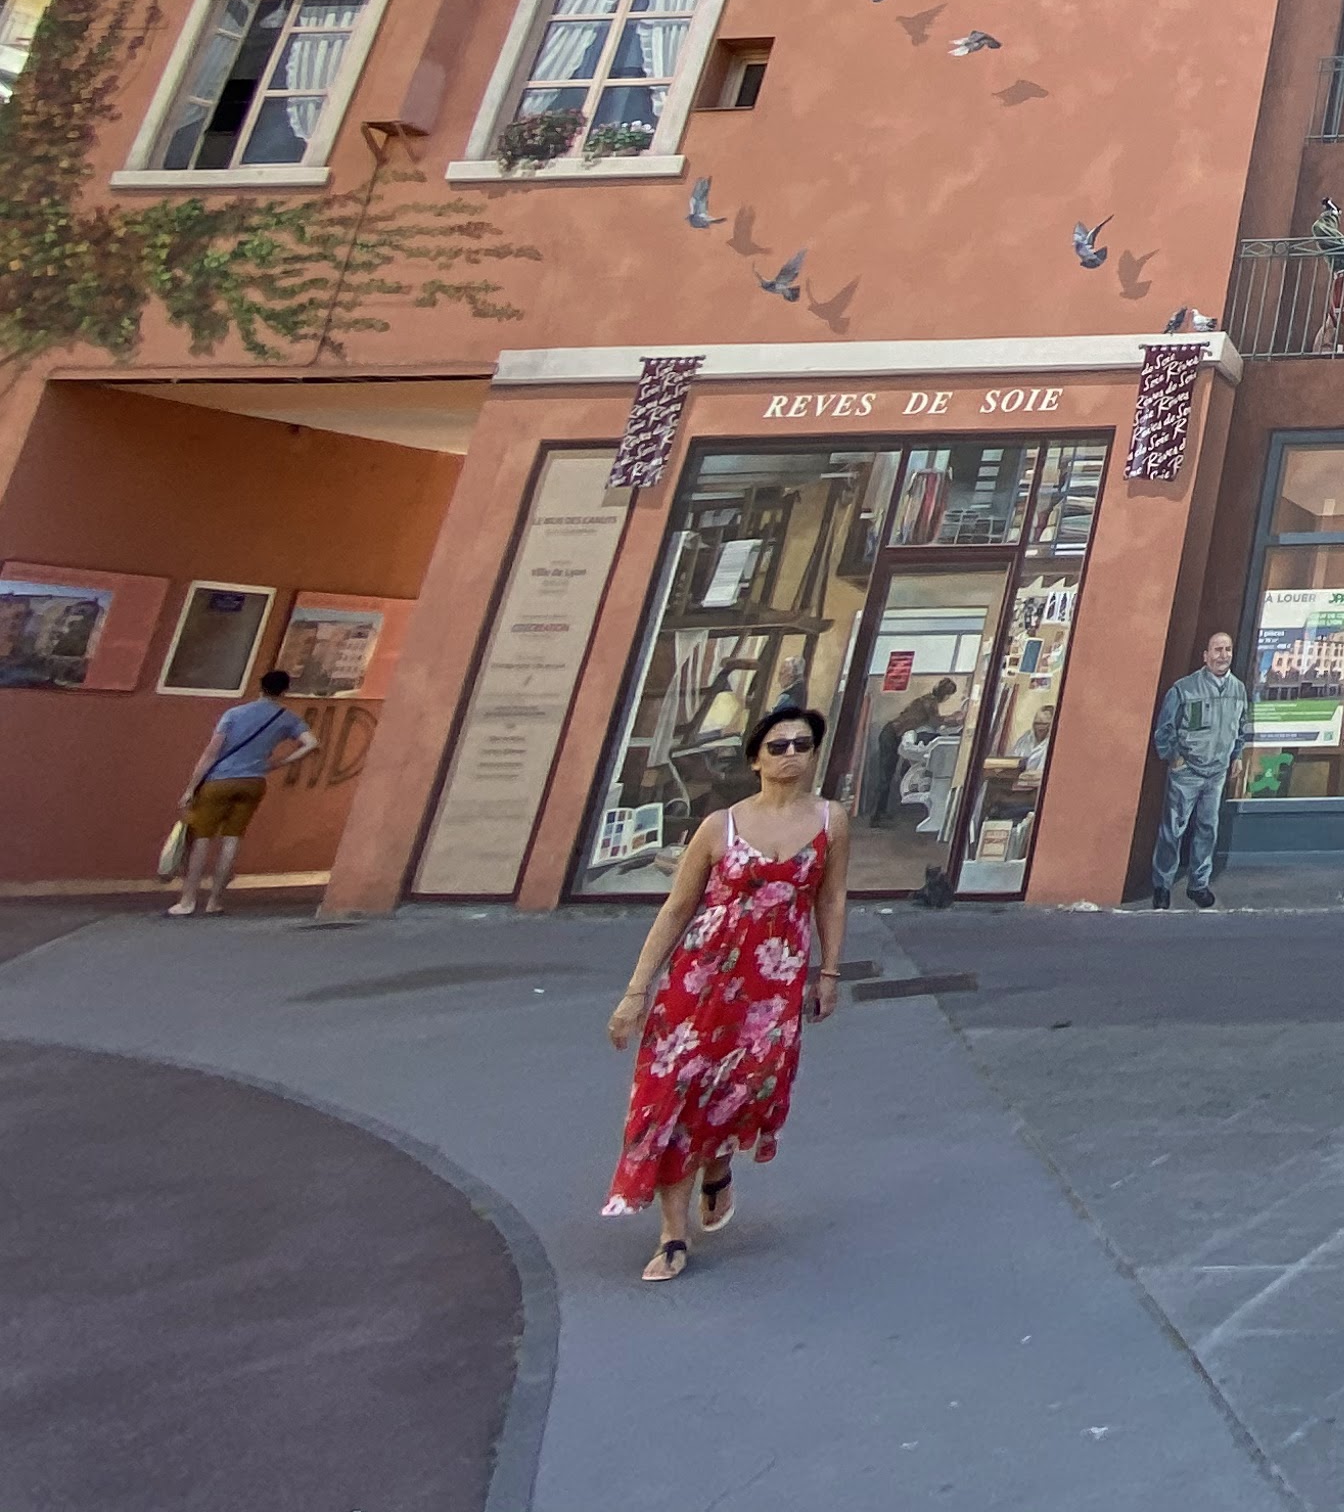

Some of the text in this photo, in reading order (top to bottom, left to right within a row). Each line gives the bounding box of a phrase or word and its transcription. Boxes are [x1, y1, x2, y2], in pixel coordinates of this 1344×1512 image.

[763, 387, 1064, 418] REVES DE SOIE
[1277, 593, 1317, 603] LOUER
